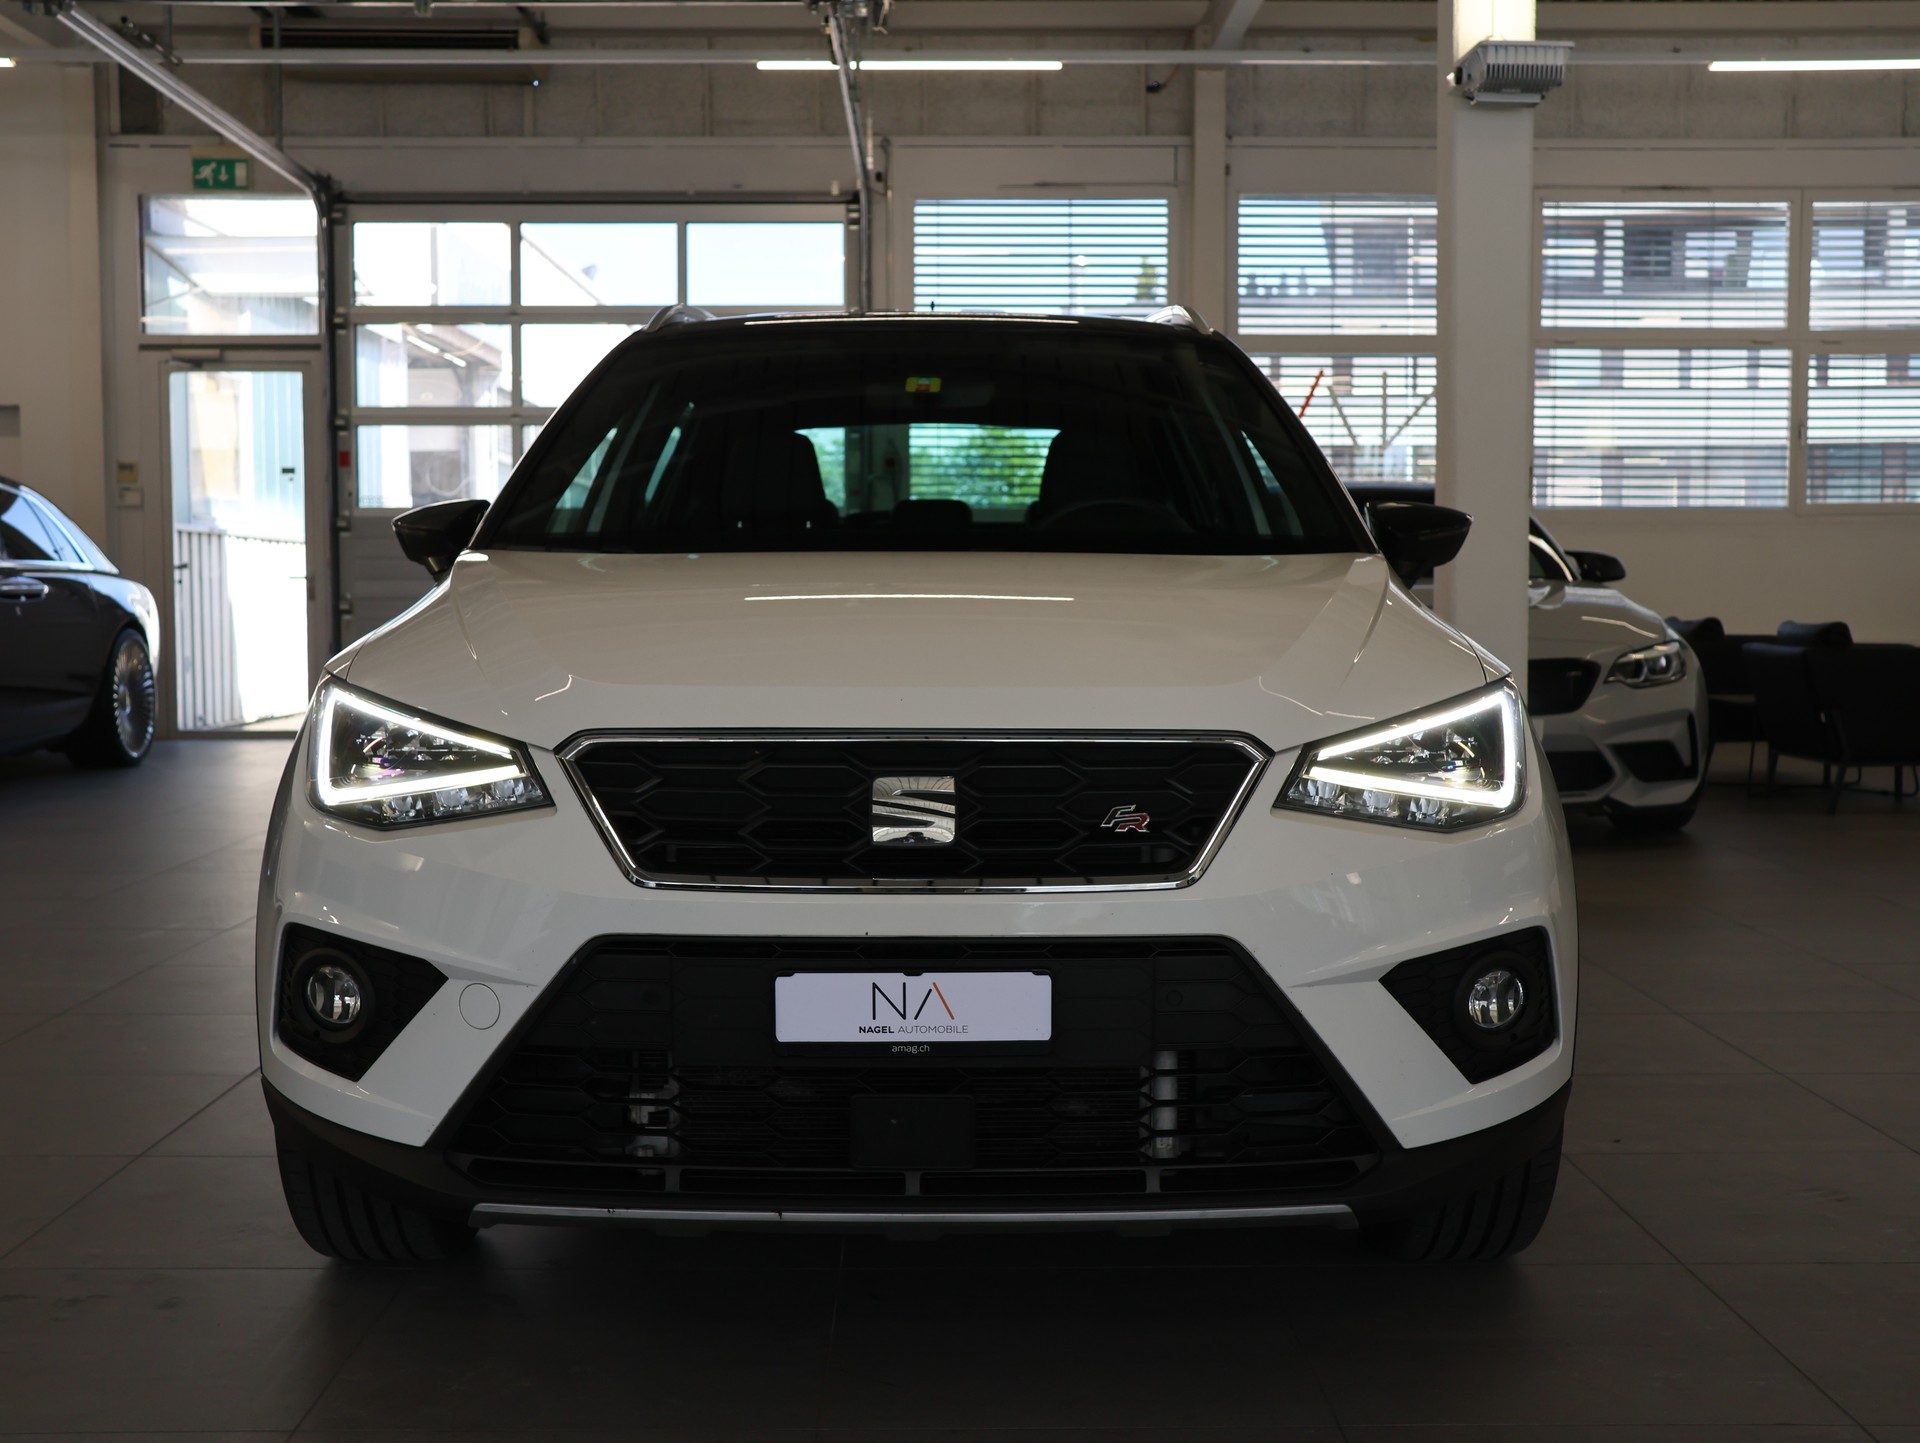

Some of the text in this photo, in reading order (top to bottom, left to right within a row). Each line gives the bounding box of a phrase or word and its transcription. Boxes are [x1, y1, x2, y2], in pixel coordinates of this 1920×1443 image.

[1101, 804, 1150, 833] FR
[858, 1025, 969, 1034] NAGEL AUTOMOBILE
[891, 1044, 931, 1054] amag.ch
